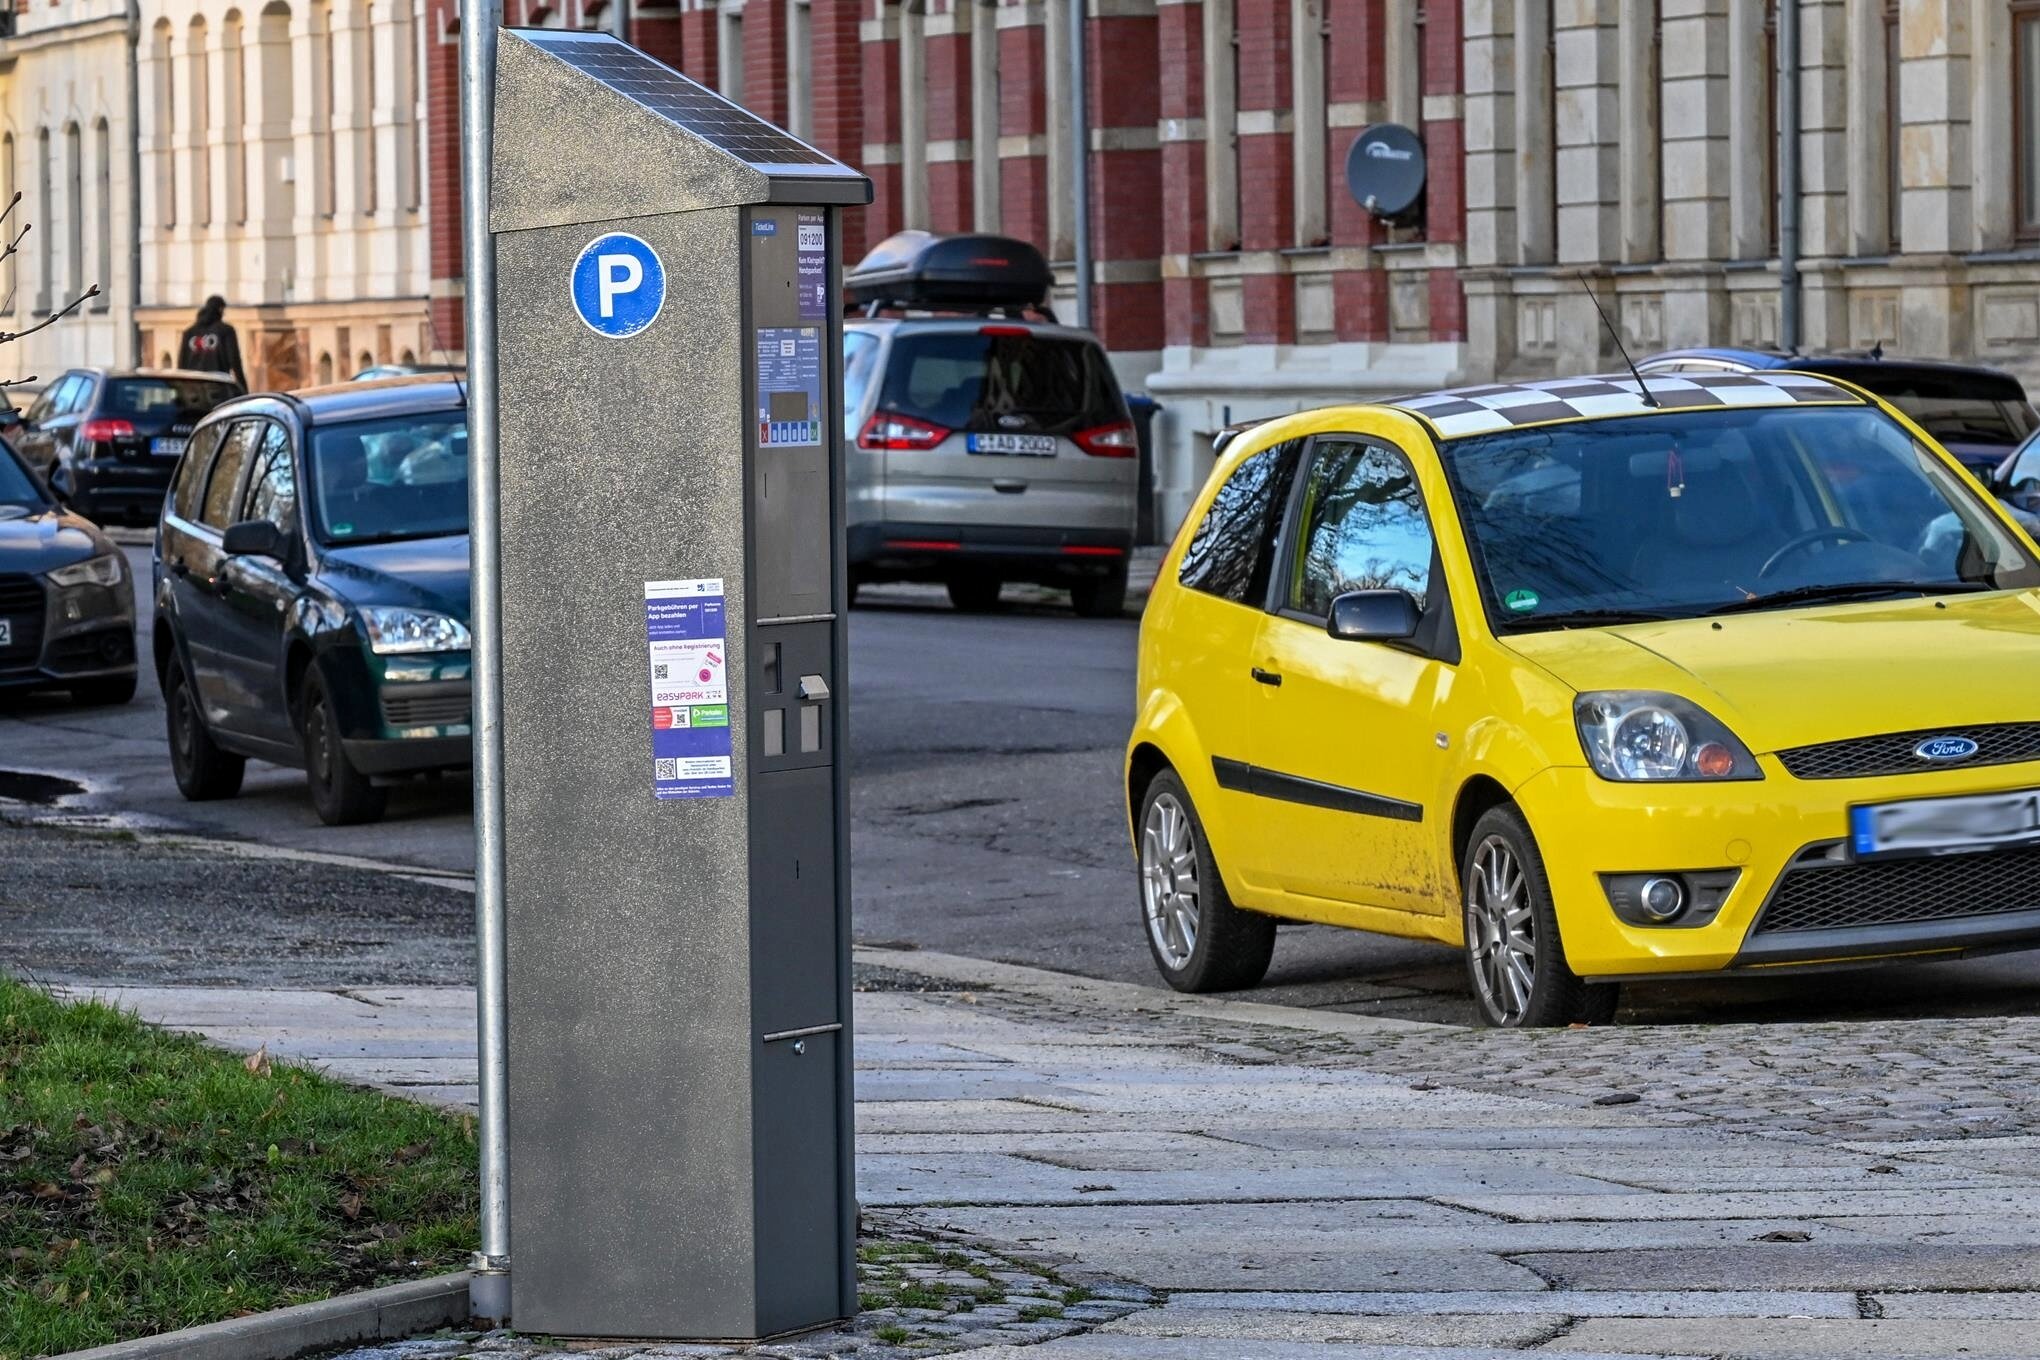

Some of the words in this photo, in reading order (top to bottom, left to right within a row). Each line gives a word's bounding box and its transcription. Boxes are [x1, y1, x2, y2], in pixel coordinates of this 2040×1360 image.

[800, 233, 823, 245] 091200
[598, 254, 643, 318] P
[1931, 741, 1966, 755] Ford
